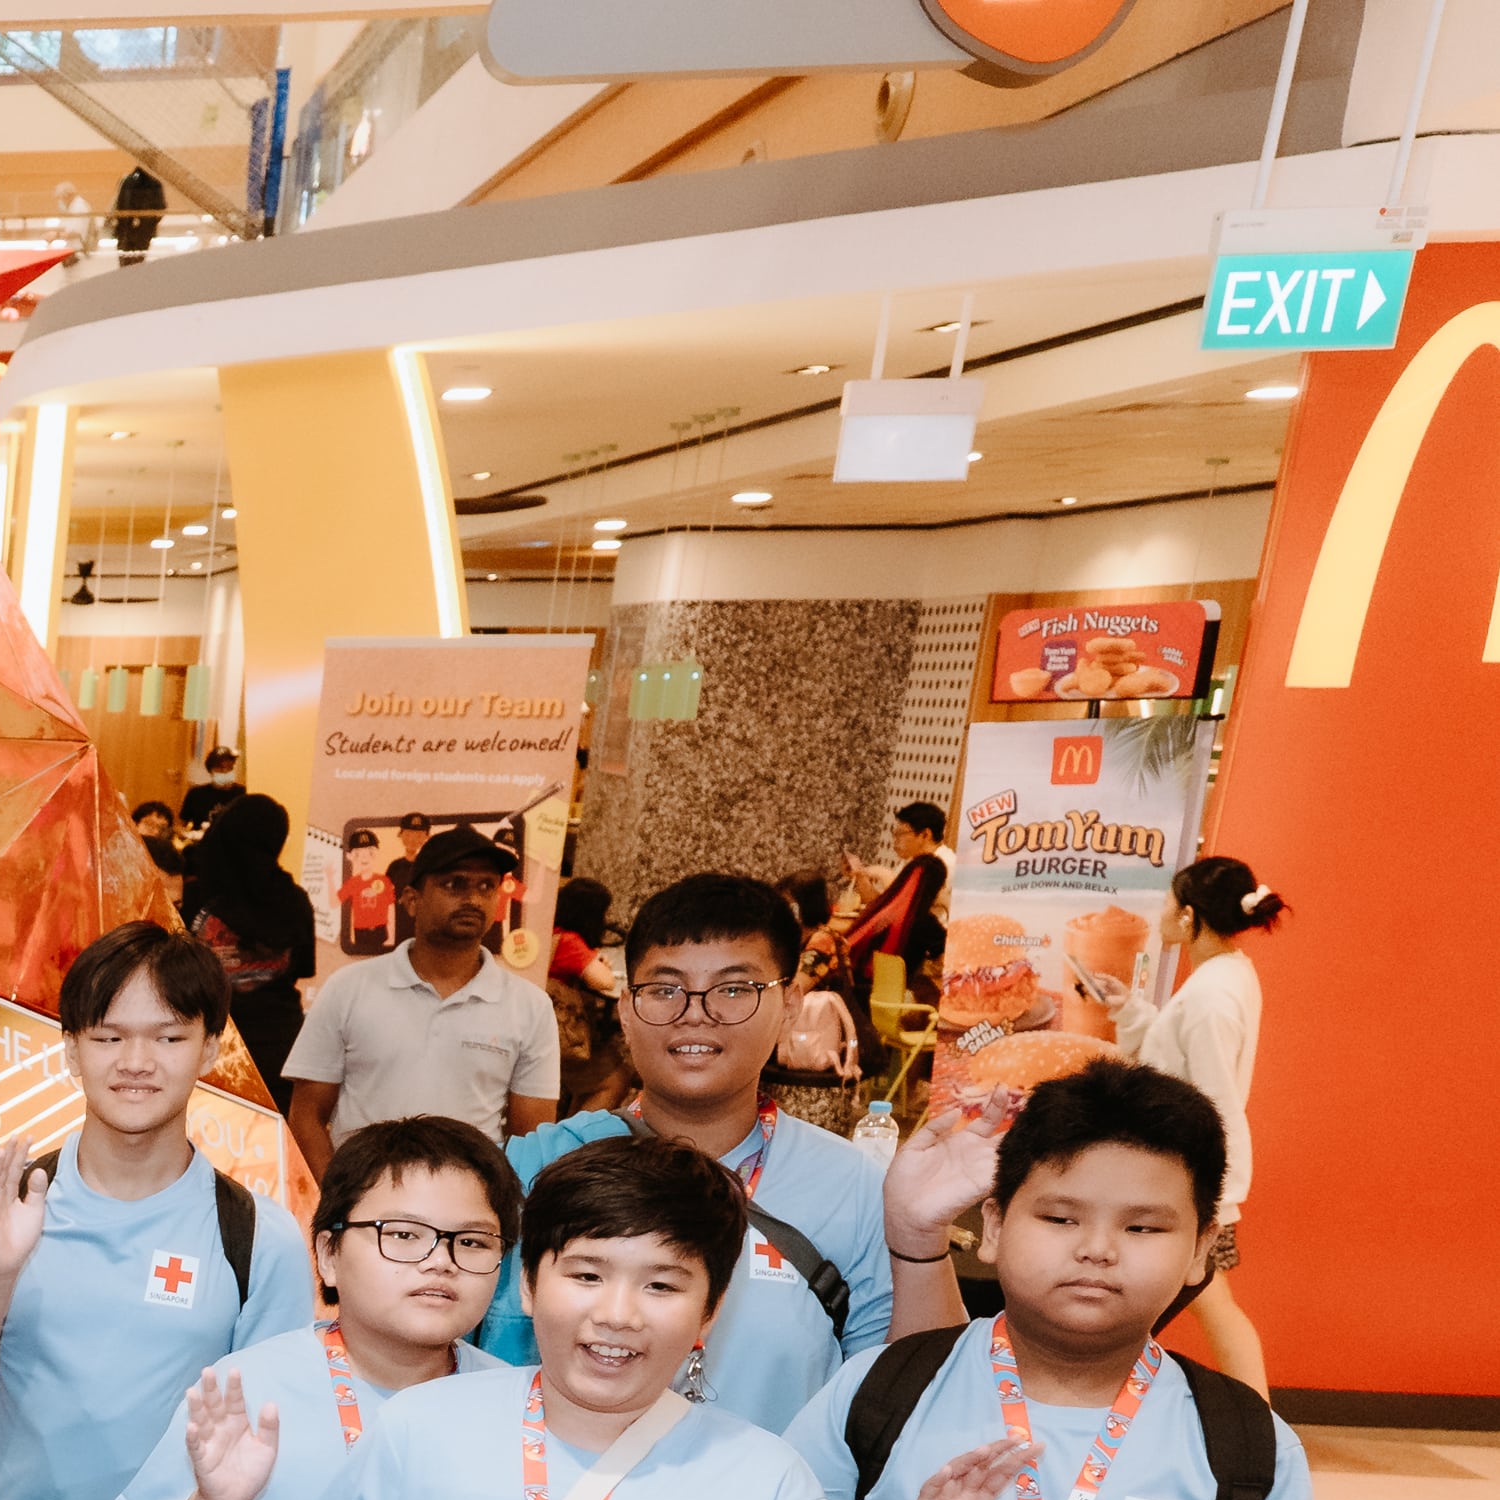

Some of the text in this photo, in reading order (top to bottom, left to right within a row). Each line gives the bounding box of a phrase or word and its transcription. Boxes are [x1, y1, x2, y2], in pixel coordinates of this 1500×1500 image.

[1217, 269, 1355, 335] EXIT
[1040, 611, 1159, 639] Fish Nuggets
[345, 691, 566, 719] Join our Team
[325, 726, 573, 756] Students are welcomed!
[367, 769, 388, 781] and
[433, 769, 486, 783] students
[513, 773, 545, 786] apply
[970, 792, 1013, 823] NEW
[1015, 857, 1107, 879] BURGER
[1001, 881, 1028, 893] SLOW
[1030, 880, 1060, 890] DOWN
[1062, 880, 1083, 889] AND
[993, 934, 1042, 946] Chicken
[956, 1019, 992, 1048] SABAI
[755, 1268, 795, 1281] SINGAPORE
[150, 1291, 189, 1305] SINGAPORE
